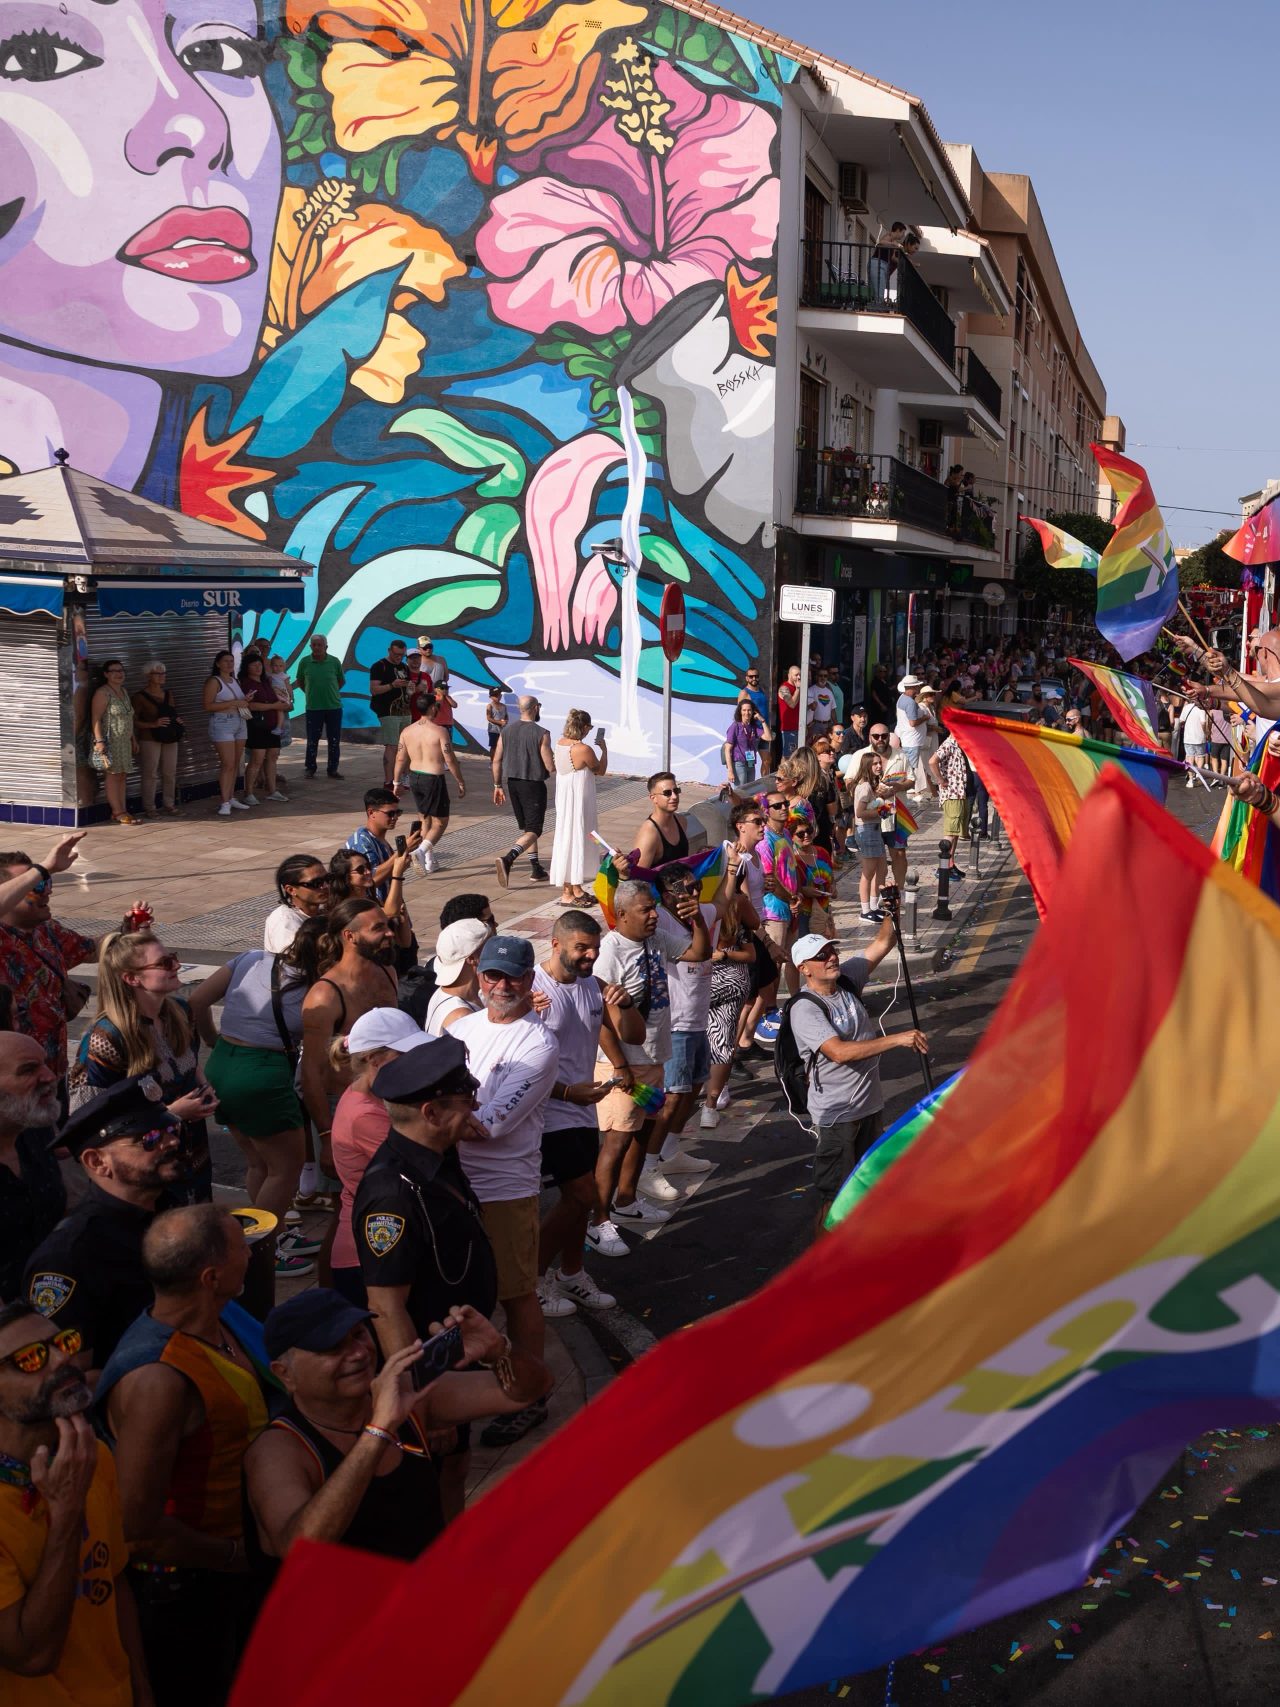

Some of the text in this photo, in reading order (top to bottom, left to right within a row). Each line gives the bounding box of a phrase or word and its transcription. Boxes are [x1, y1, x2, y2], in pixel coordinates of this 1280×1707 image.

[181, 590, 242, 608] Diario SUR
[791, 603, 823, 612] LUNES
[505, 1080, 531, 1111] CREW
